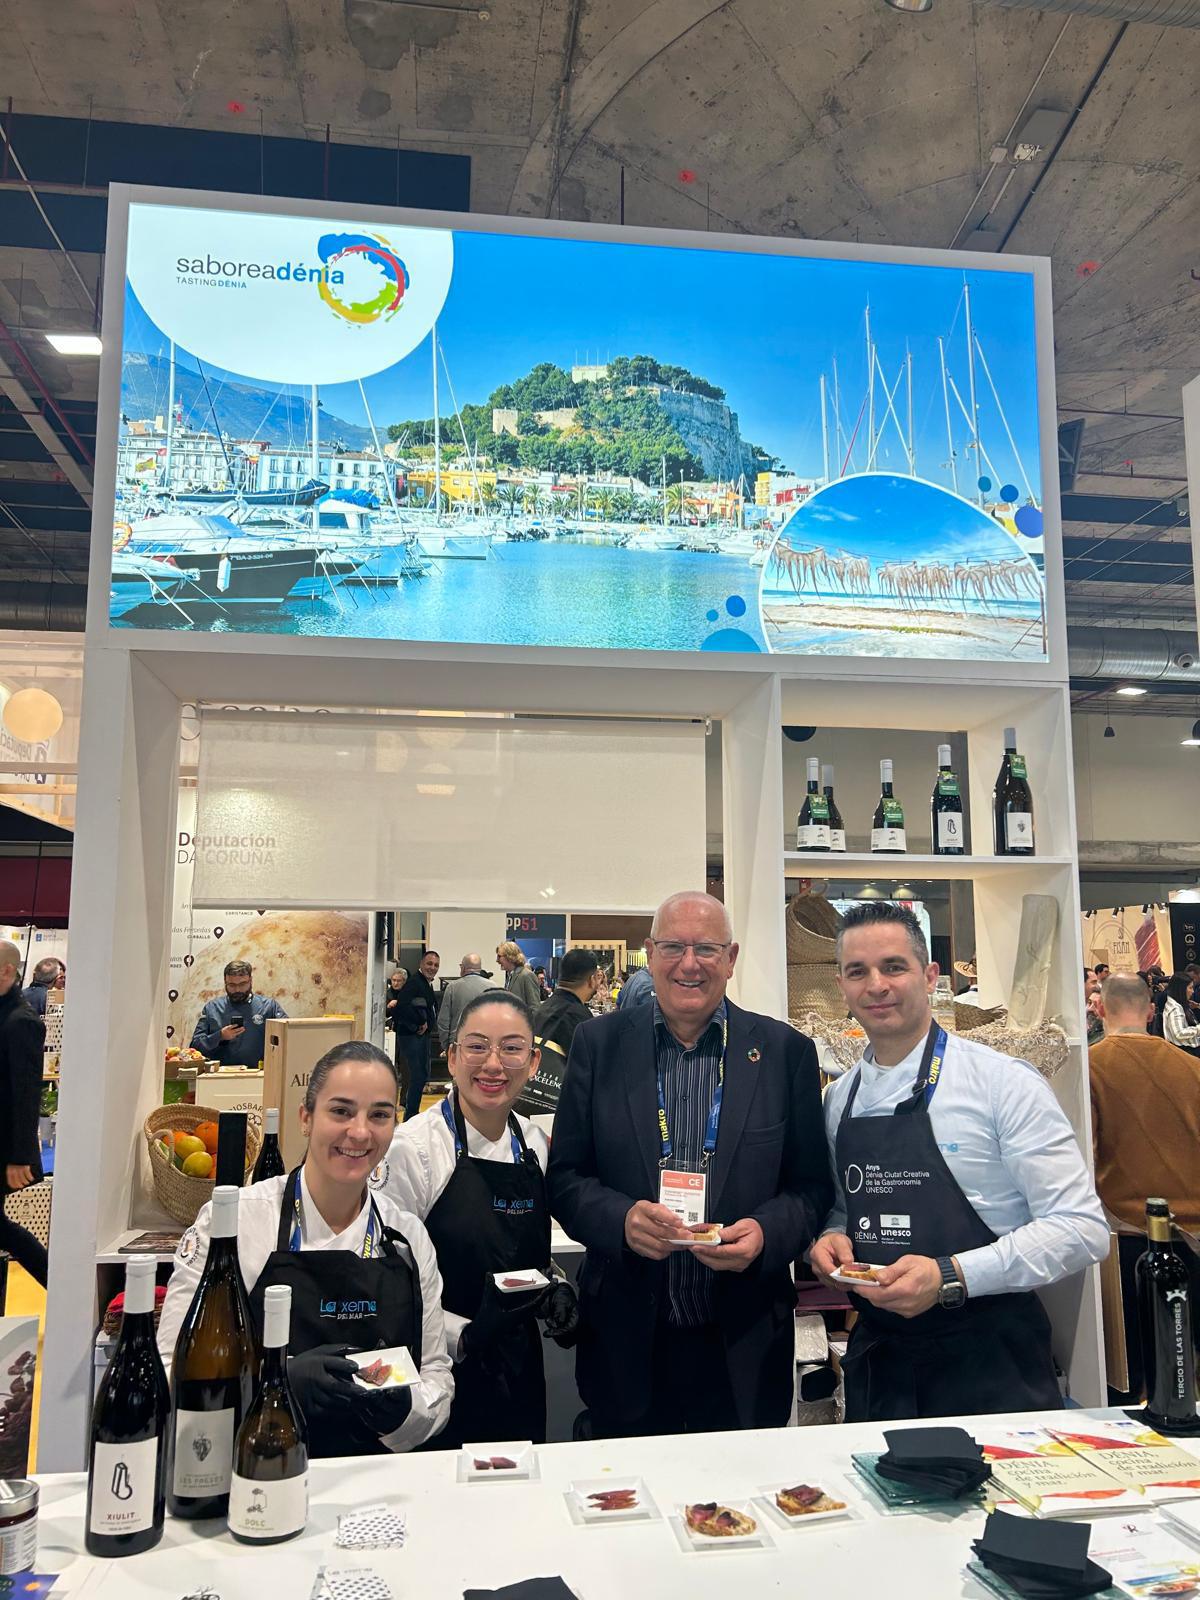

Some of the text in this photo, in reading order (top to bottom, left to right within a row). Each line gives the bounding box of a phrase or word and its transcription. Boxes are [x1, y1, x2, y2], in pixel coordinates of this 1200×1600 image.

[176, 254, 345, 285] saboreadénia
[177, 849, 198, 864] DA
[928, 1056, 942, 1084] makro
[658, 1108, 670, 1142] makro
[866, 1163, 881, 1172] Anys
[884, 1171, 903, 1179] Ciutat
[903, 1170, 930, 1179] Creativa
[688, 1178, 701, 1187] CE
[865, 1186, 893, 1194] UNESCO
[854, 1230, 878, 1240] DÉNIA
[880, 1229, 912, 1237] unesco
[1174, 1302, 1186, 1399] TERCIO DE LAS TORRES
[1116, 1459, 1197, 1473] de tradición
[1014, 1470, 1097, 1483] de tradición
[1123, 1470, 1134, 1479] y
[1021, 1480, 1033, 1490] y
